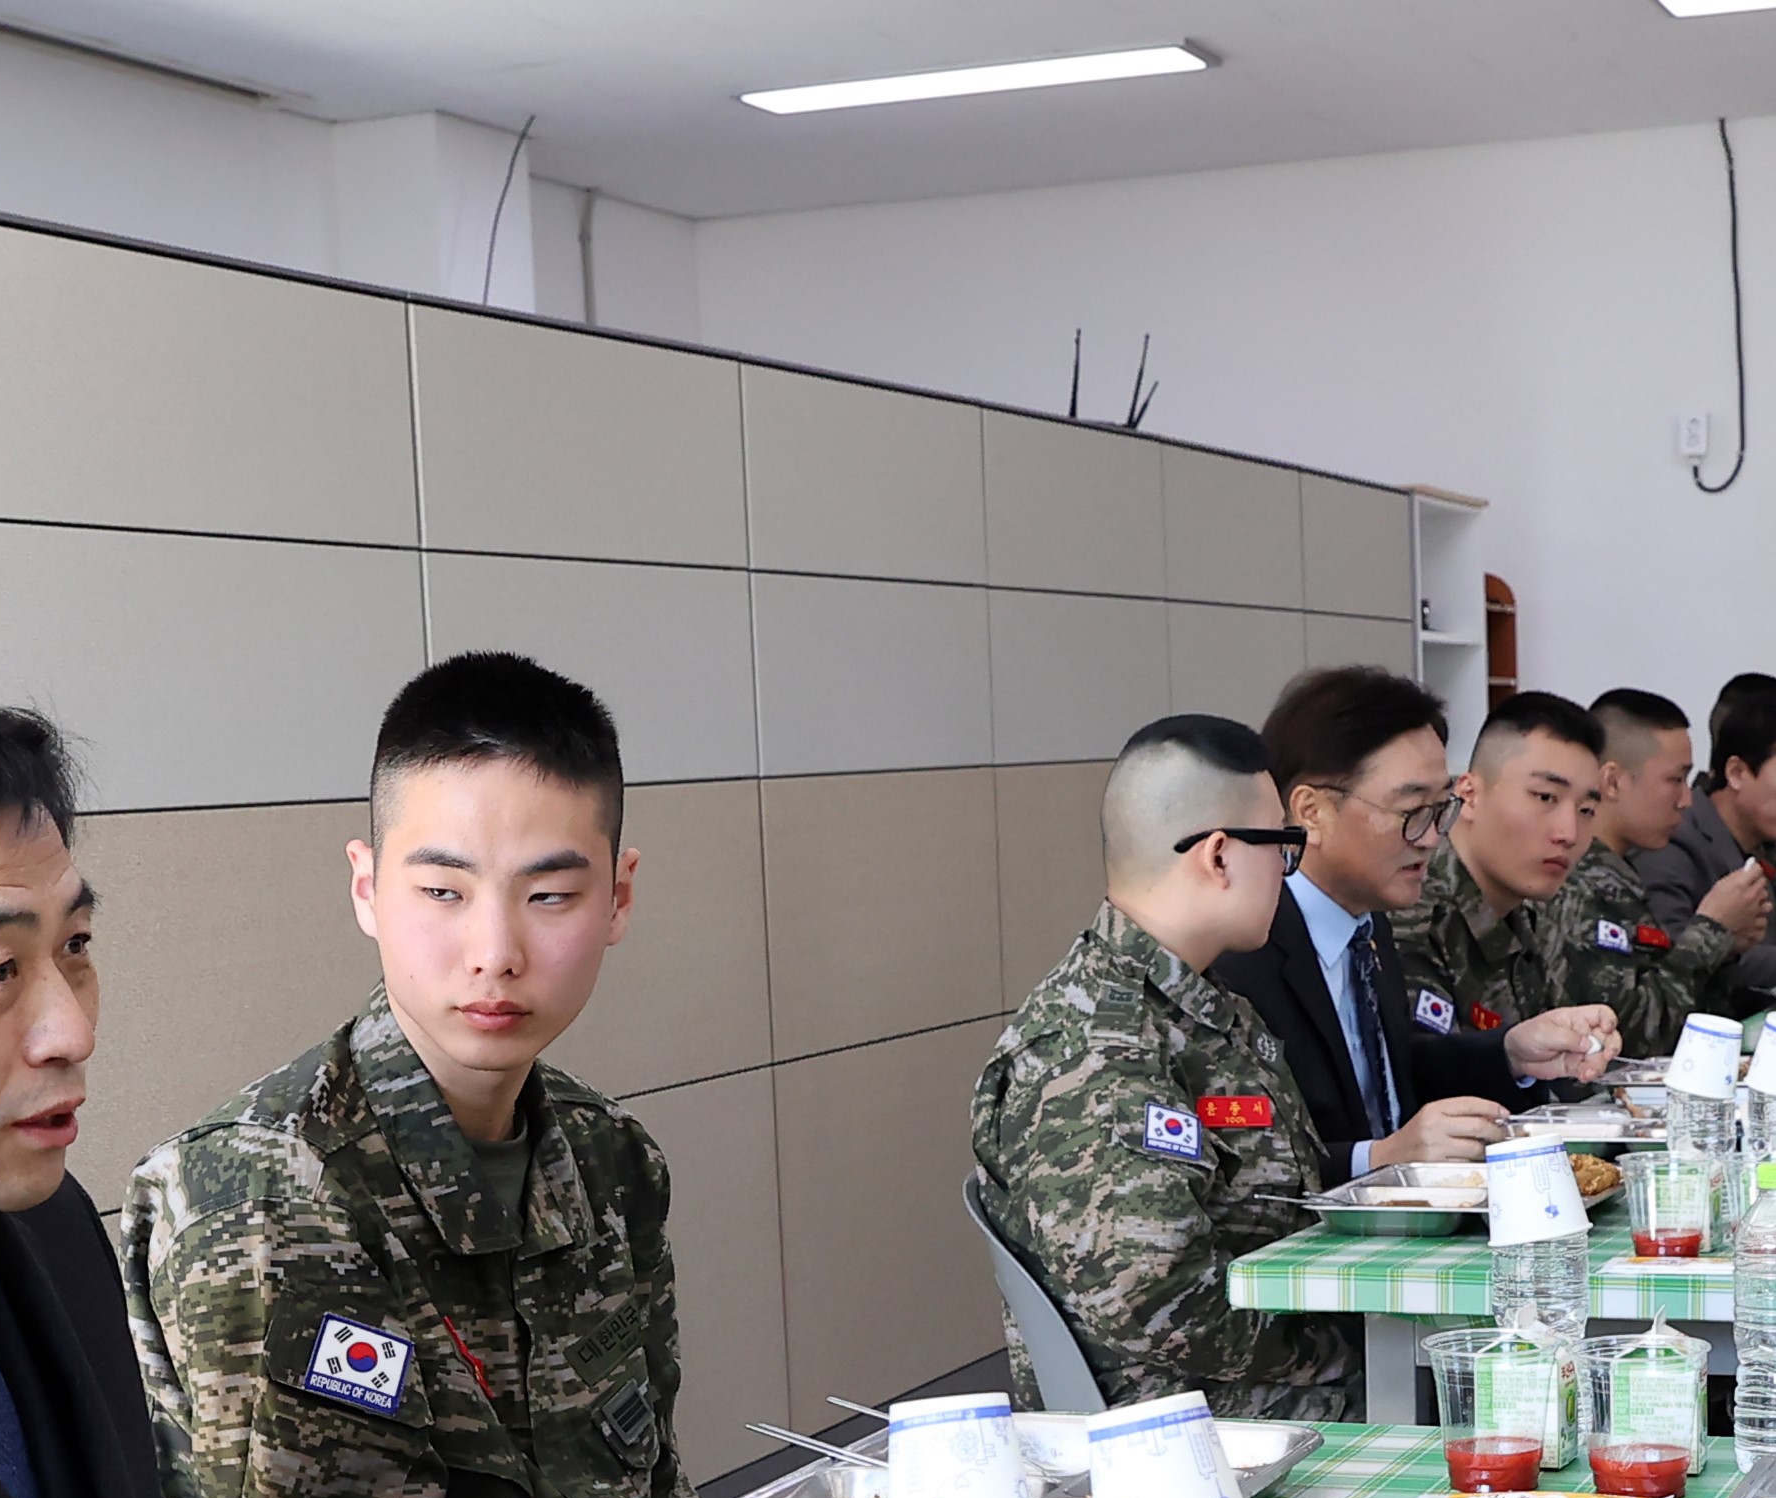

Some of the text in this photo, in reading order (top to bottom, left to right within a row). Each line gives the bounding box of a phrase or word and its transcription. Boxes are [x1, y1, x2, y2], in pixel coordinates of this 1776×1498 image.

[577, 1305, 639, 1364] 대한민국
[309, 1374, 393, 1409] REPUBLIC OF KOREA
